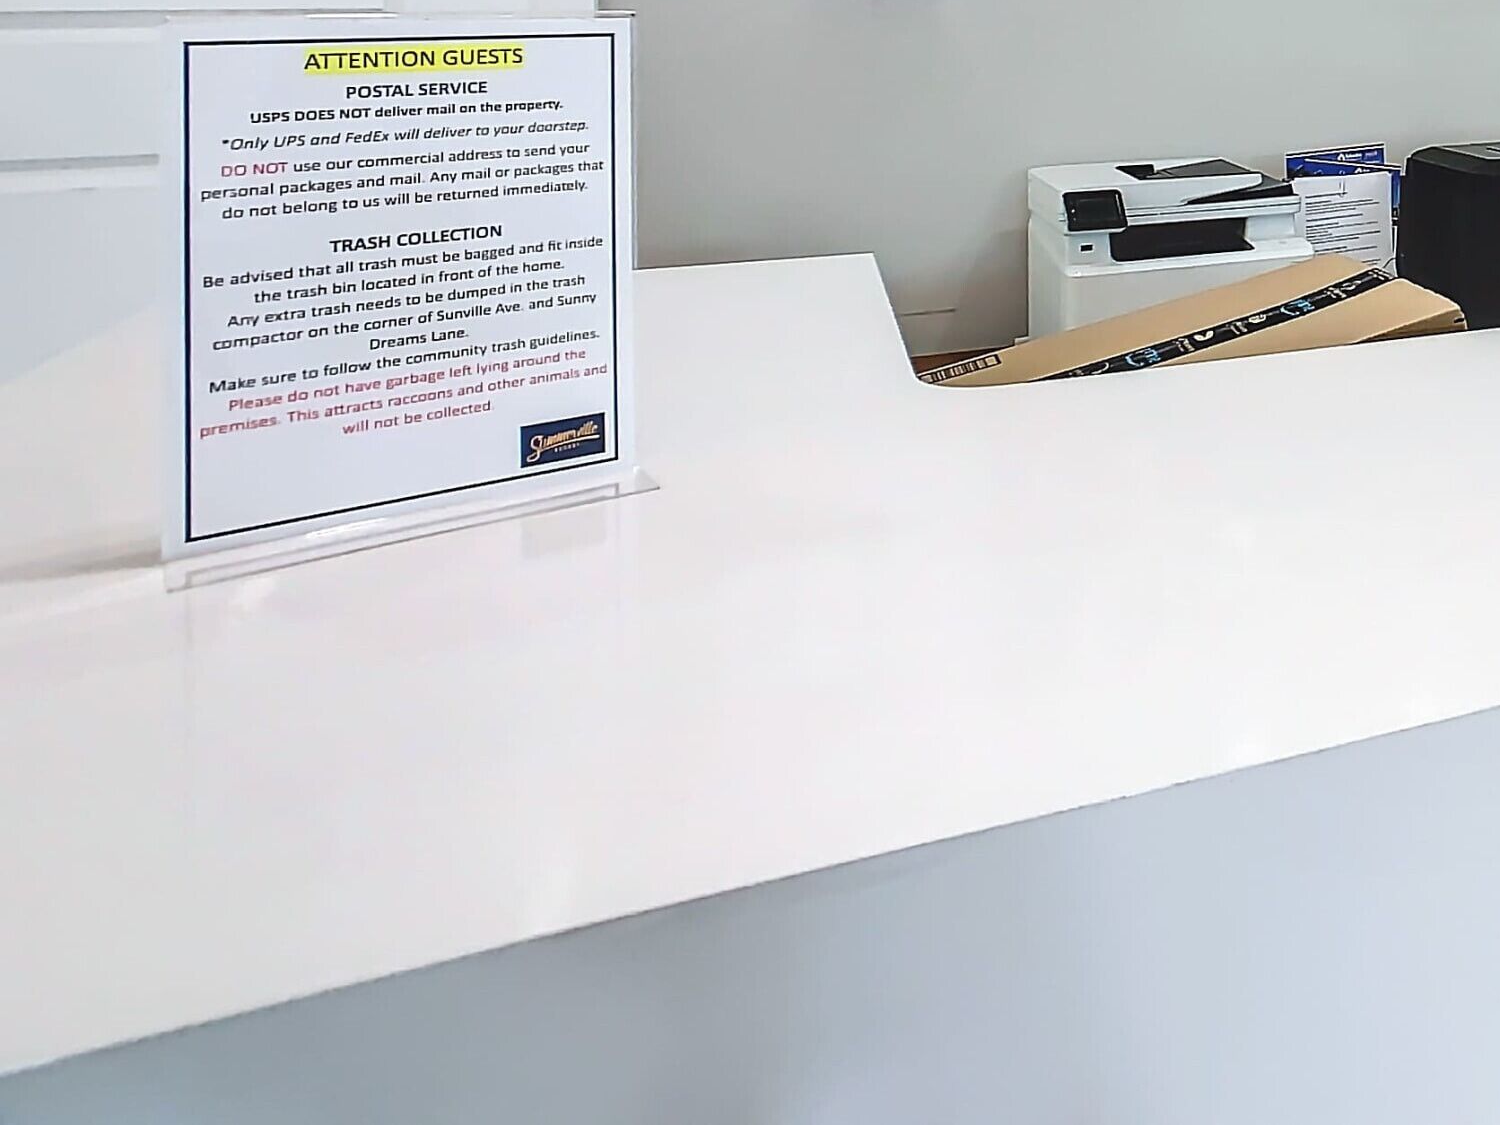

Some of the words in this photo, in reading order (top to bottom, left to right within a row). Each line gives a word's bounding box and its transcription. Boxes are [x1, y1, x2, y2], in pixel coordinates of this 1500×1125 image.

[302, 50, 437, 70] ATTENTION
[441, 47, 525, 66] GUESTS
[345, 83, 416, 100] POSTAL
[417, 80, 489, 97] SERVICE
[249, 111, 292, 124] USPS
[293, 109, 337, 122] DOES
[338, 107, 373, 120] NOT
[373, 105, 425, 118] deliver
[425, 103, 457, 115] mail
[458, 104, 478, 114] on
[479, 101, 504, 113] the
[504, 100, 565, 114] property.
[272, 134, 307, 148] UPS
[309, 131, 343, 146] and
[343, 130, 391, 144] FedEx
[393, 127, 422, 141] will
[422, 126, 474, 140] deliver
[474, 126, 491, 137] to
[492, 125, 526, 138] your
[526, 121, 590, 134] doorstep.
[220, 164, 248, 178] DO
[252, 161, 290, 175] NOT
[292, 161, 322, 173] use
[324, 159, 354, 171] our
[356, 150, 445, 169] commercial
[447, 148, 504, 163] address
[505, 148, 522, 159] to
[523, 143, 557, 157] send
[558, 144, 591, 157] your
[200, 182, 275, 203] personal
[278, 179, 353, 197] packages
[355, 174, 386, 189] and
[429, 171, 459, 184] Any
[460, 166, 492, 181] mail
[494, 168, 511, 178] or
[513, 163, 575, 179] packages
[577, 160, 605, 172] that
[220, 206, 246, 220] do
[247, 204, 279, 218] not
[281, 200, 339, 215] belong
[340, 198, 360, 210] to
[361, 197, 381, 208] us
[382, 192, 411, 206] will
[413, 191, 434, 204] be
[435, 185, 500, 202] returned
[501, 179, 589, 197] immediately.
[327, 234, 392, 253] TRASH
[395, 224, 503, 247] COLLECTION
[202, 275, 225, 289] Be
[228, 266, 295, 286] advised
[297, 264, 333, 279] that
[334, 260, 355, 275] all
[357, 256, 398, 272] trash
[400, 253, 440, 268] must
[441, 251, 462, 263] be
[463, 244, 516, 261] bagged
[517, 241, 545, 255] and
[546, 240, 563, 252] fit
[564, 236, 604, 250] inside
[252, 289, 283, 304] the
[285, 283, 331, 300] trash
[330, 280, 358, 295] bin
[359, 273, 418, 292] located
[419, 272, 436, 285] in
[437, 268, 476, 283] front
[476, 264, 494, 279] of
[494, 263, 521, 277] the
[521, 260, 566, 274] home.
[226, 314, 261, 328] Any
[263, 309, 307, 323] extra
[310, 301, 352, 318] trash
[354, 295, 403, 313] needs
[404, 295, 422, 307] to
[424, 291, 445, 304] be
[446, 283, 507, 301] dumped
[509, 282, 523, 294] in
[525, 279, 550, 292] the
[551, 274, 586, 289] trash
[211, 329, 305, 351] compactor
[307, 326, 330, 339] on
[332, 321, 361, 335] the
[362, 315, 415, 331] corner
[416, 310, 435, 324] of
[435, 304, 493, 322] Sunville
[527, 296, 555, 310] and
[556, 293, 598, 307] Sunny
[368, 333, 428, 351] Dreams
[430, 329, 470, 342] Lane.
[208, 377, 257, 394] Make
[260, 372, 298, 387] sure
[300, 369, 320, 381] to
[322, 361, 373, 377] follow
[375, 356, 402, 370] the
[404, 344, 489, 365] community
[490, 338, 527, 353] trash
[528, 330, 601, 350] guidelines.
[227, 395, 284, 412] Please
[286, 389, 310, 403] do
[312, 384, 342, 399] not
[343, 380, 383, 394] have
[384, 370, 447, 391] garbage
[448, 364, 474, 378] left
[475, 361, 511, 376] lying
[511, 351, 562, 369] around
[563, 349, 587, 361] the
[286, 410, 320, 423] This
[323, 399, 384, 418] attracts
[386, 389, 454, 408] raccoons
[456, 381, 485, 397] and
[486, 377, 527, 392] other
[528, 368, 581, 385] animals
[582, 363, 608, 377] and
[341, 418, 370, 435] will
[373, 416, 399, 430] not
[403, 412, 423, 425] be
